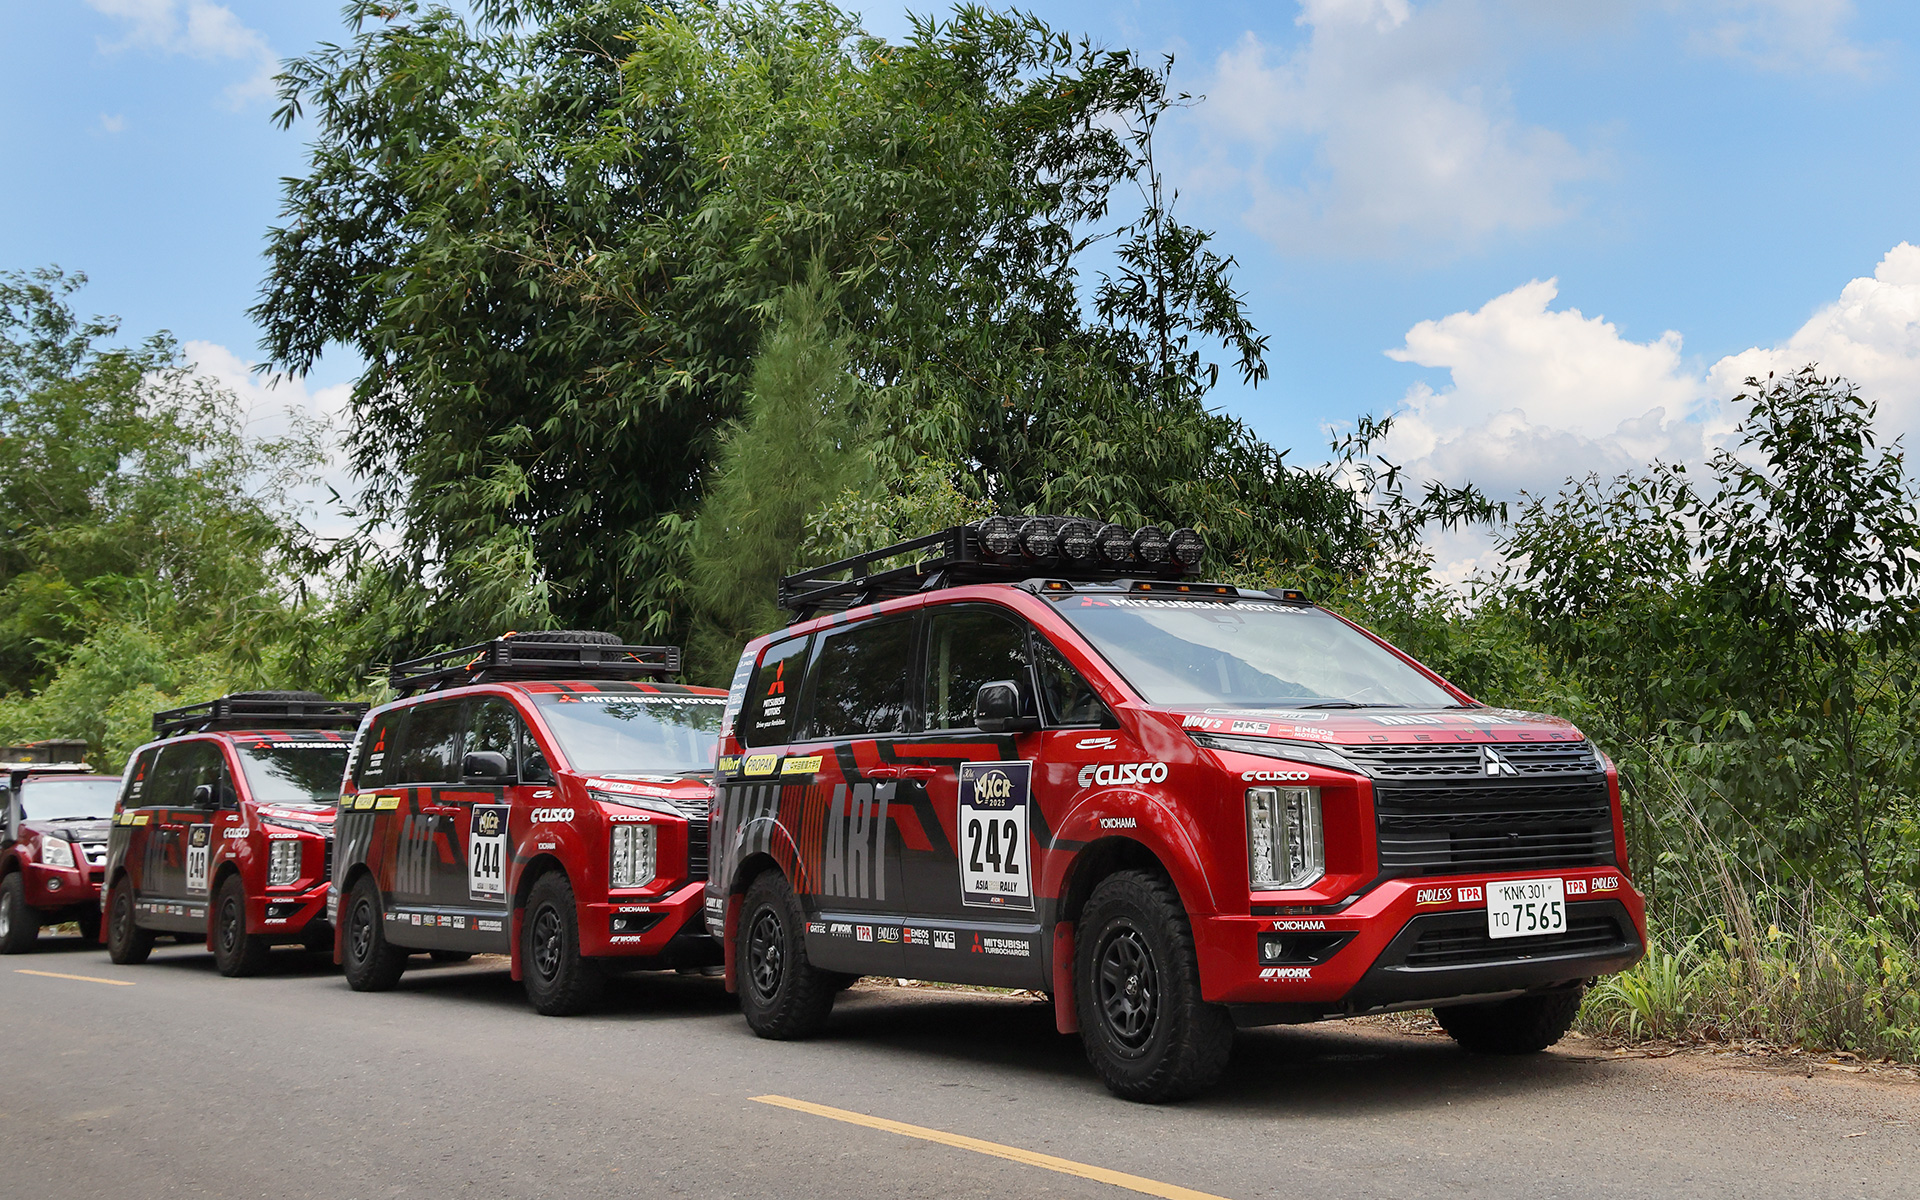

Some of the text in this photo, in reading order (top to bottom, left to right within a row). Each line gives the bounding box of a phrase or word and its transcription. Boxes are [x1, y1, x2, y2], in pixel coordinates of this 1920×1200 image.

[1108, 598, 1308, 615] MITSUBISHI MOTORS
[580, 695, 673, 704] MITSUBISHI
[1181, 715, 1224, 729] Moty's
[1231, 720, 1271, 734] HKS
[1294, 725, 1335, 737] ENEOS
[1294, 732, 1320, 740] MOTOR
[746, 757, 774, 772] PROPAK
[1093, 762, 1168, 786] CUSCO
[1252, 770, 1310, 782] CUSCO
[989, 799, 1006, 807] 2025
[537, 808, 575, 823] CUSCO
[616, 814, 651, 822] CUSCO
[1099, 817, 1137, 829] YOKOHAMA
[825, 782, 897, 901] ART
[968, 818, 1020, 875] 242
[190, 852, 204, 879] 243
[474, 841, 500, 879] 244
[975, 880, 989, 891] ASIA
[999, 881, 1018, 893] RALLY
[1567, 881, 1586, 893] TPR
[1591, 876, 1619, 891] ENDLESS
[1416, 887, 1452, 904] ENDLESS
[1459, 888, 1480, 900] TPR
[1504, 884, 1546, 901] KNK 301
[1493, 901, 1562, 932] TO 7565
[1272, 920, 1326, 931] YOKOHAMA
[857, 926, 873, 940] TPR
[877, 926, 899, 941] ENDLESS
[911, 928, 930, 940] ENEOS
[934, 930, 955, 945] HKS
[983, 938, 1030, 950] MITSUBISHI
[984, 947, 1030, 957] TURBOCHARGER
[1275, 968, 1312, 978] WORK
